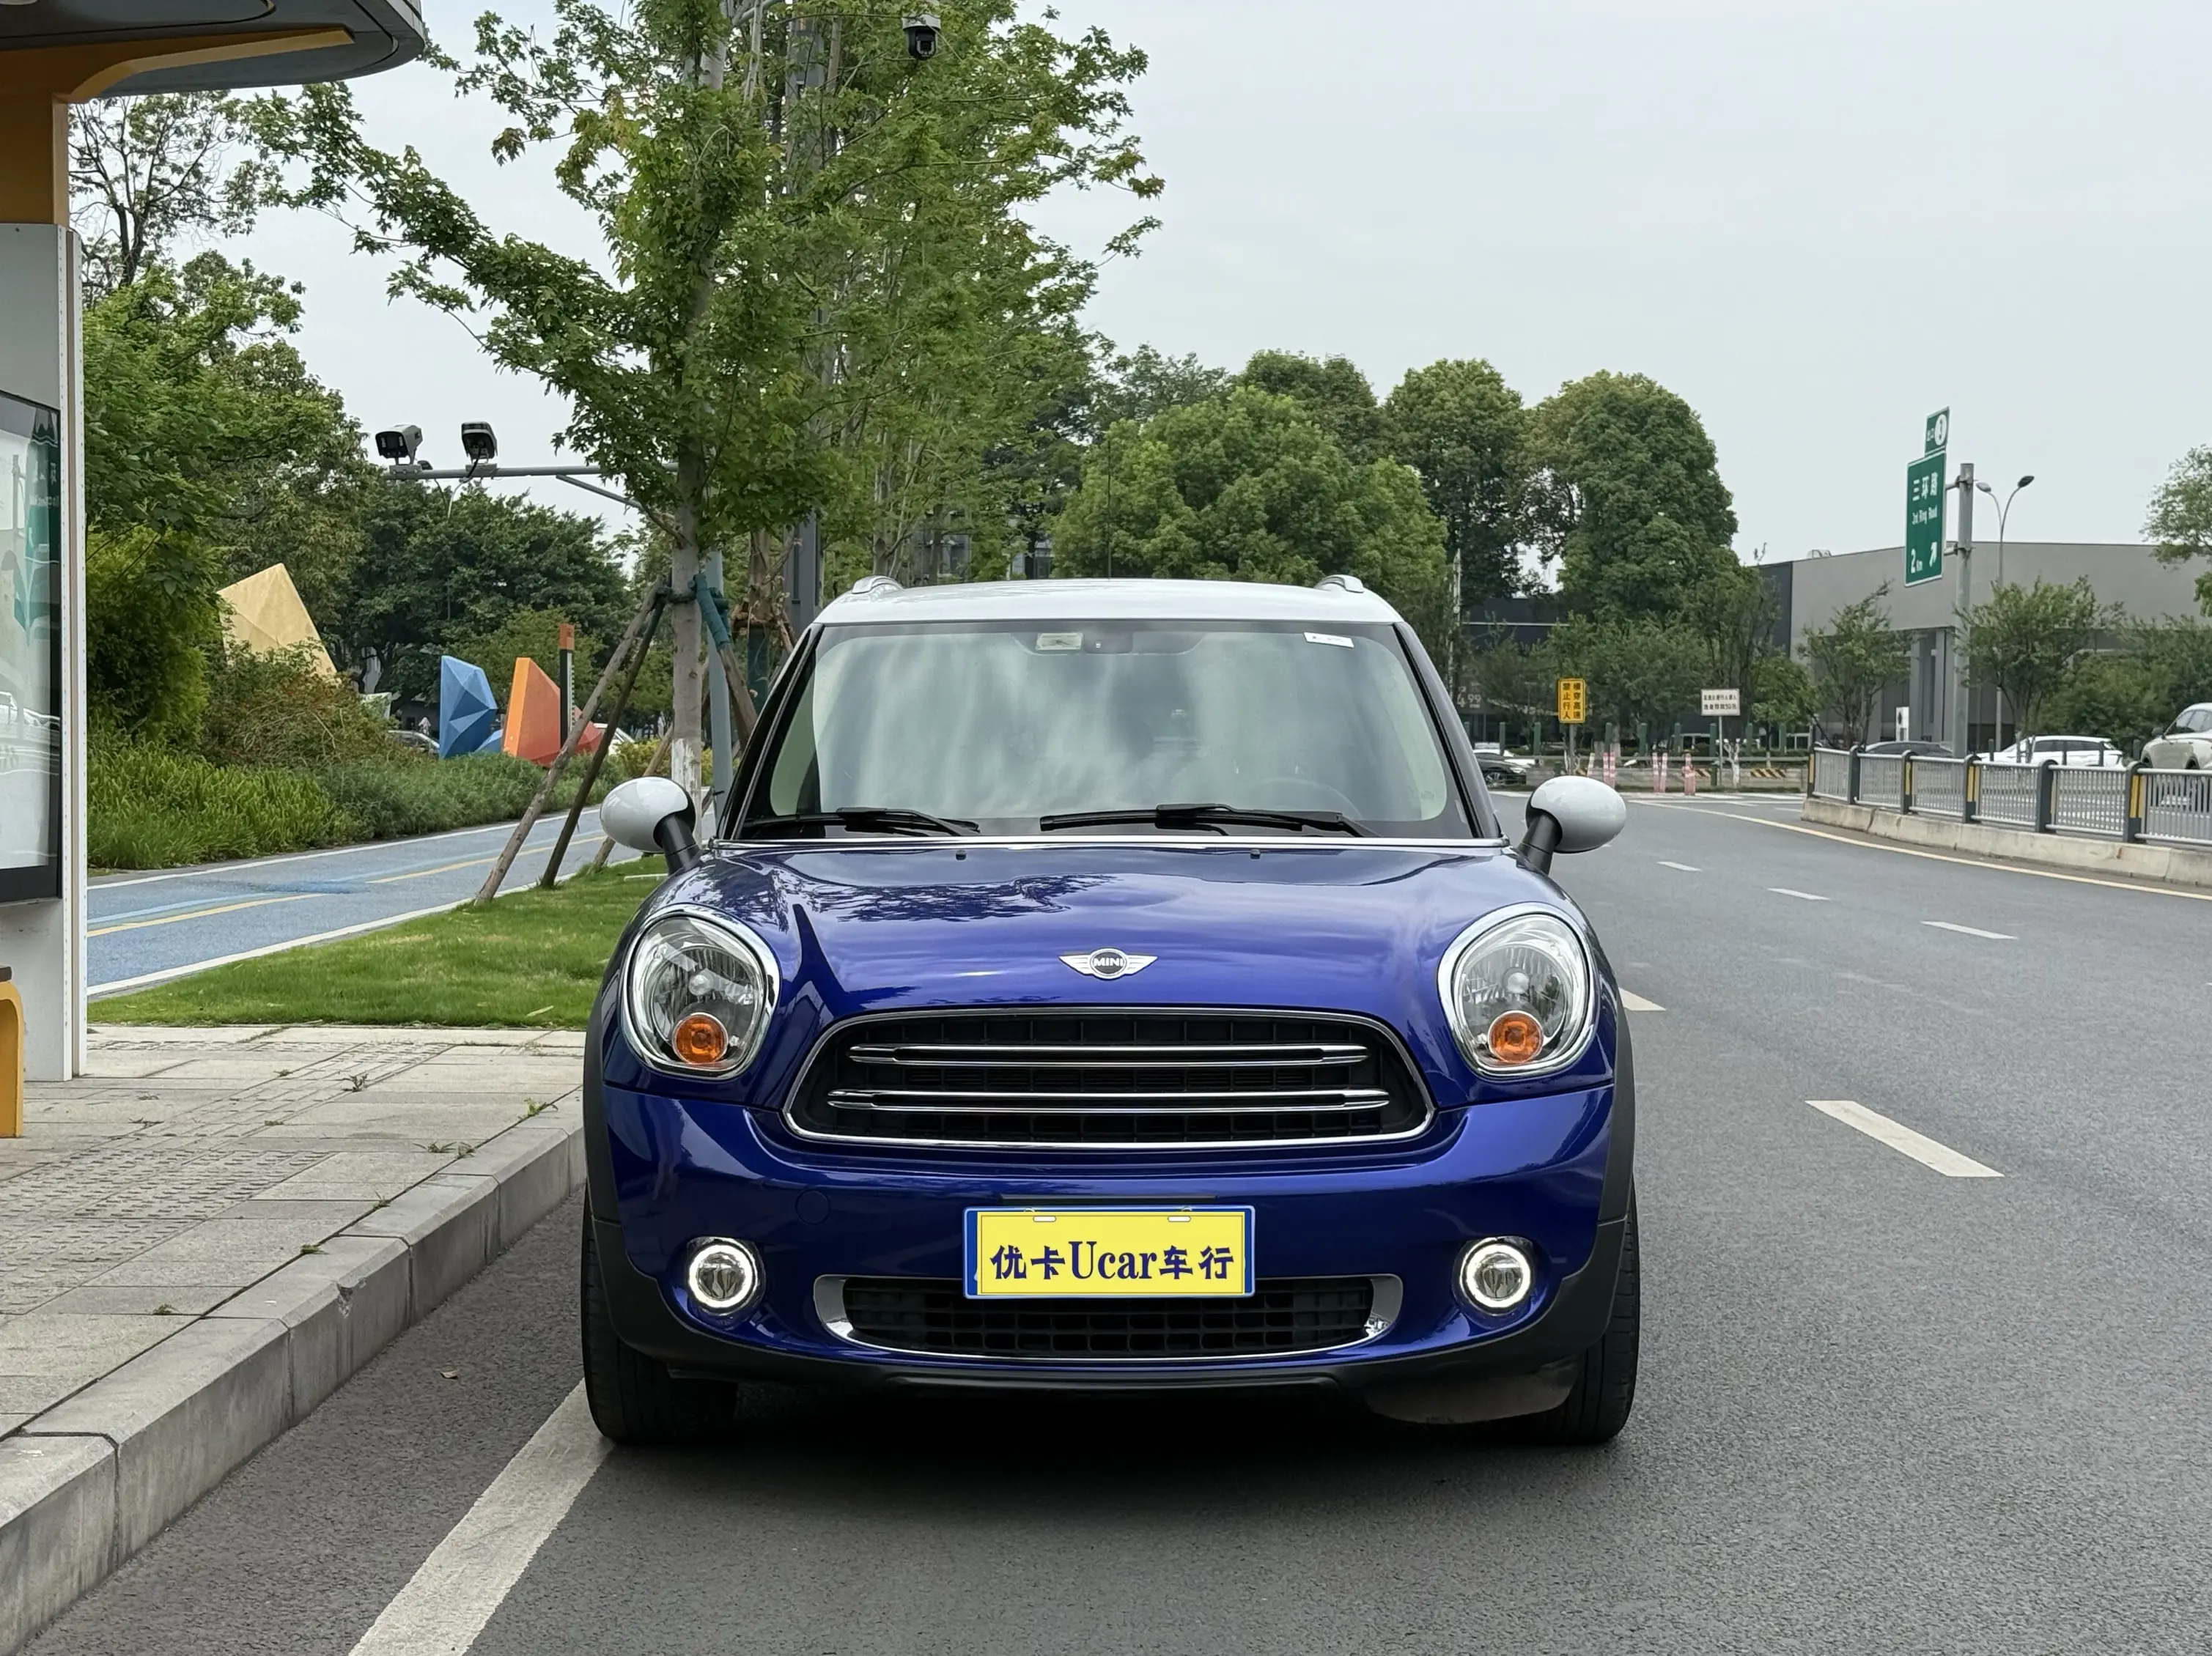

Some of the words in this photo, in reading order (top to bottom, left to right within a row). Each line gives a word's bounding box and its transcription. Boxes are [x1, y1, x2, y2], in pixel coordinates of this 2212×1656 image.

[1094, 957, 1124, 966] MINI
[991, 1241, 1234, 1279] 优卡Ucar车行
